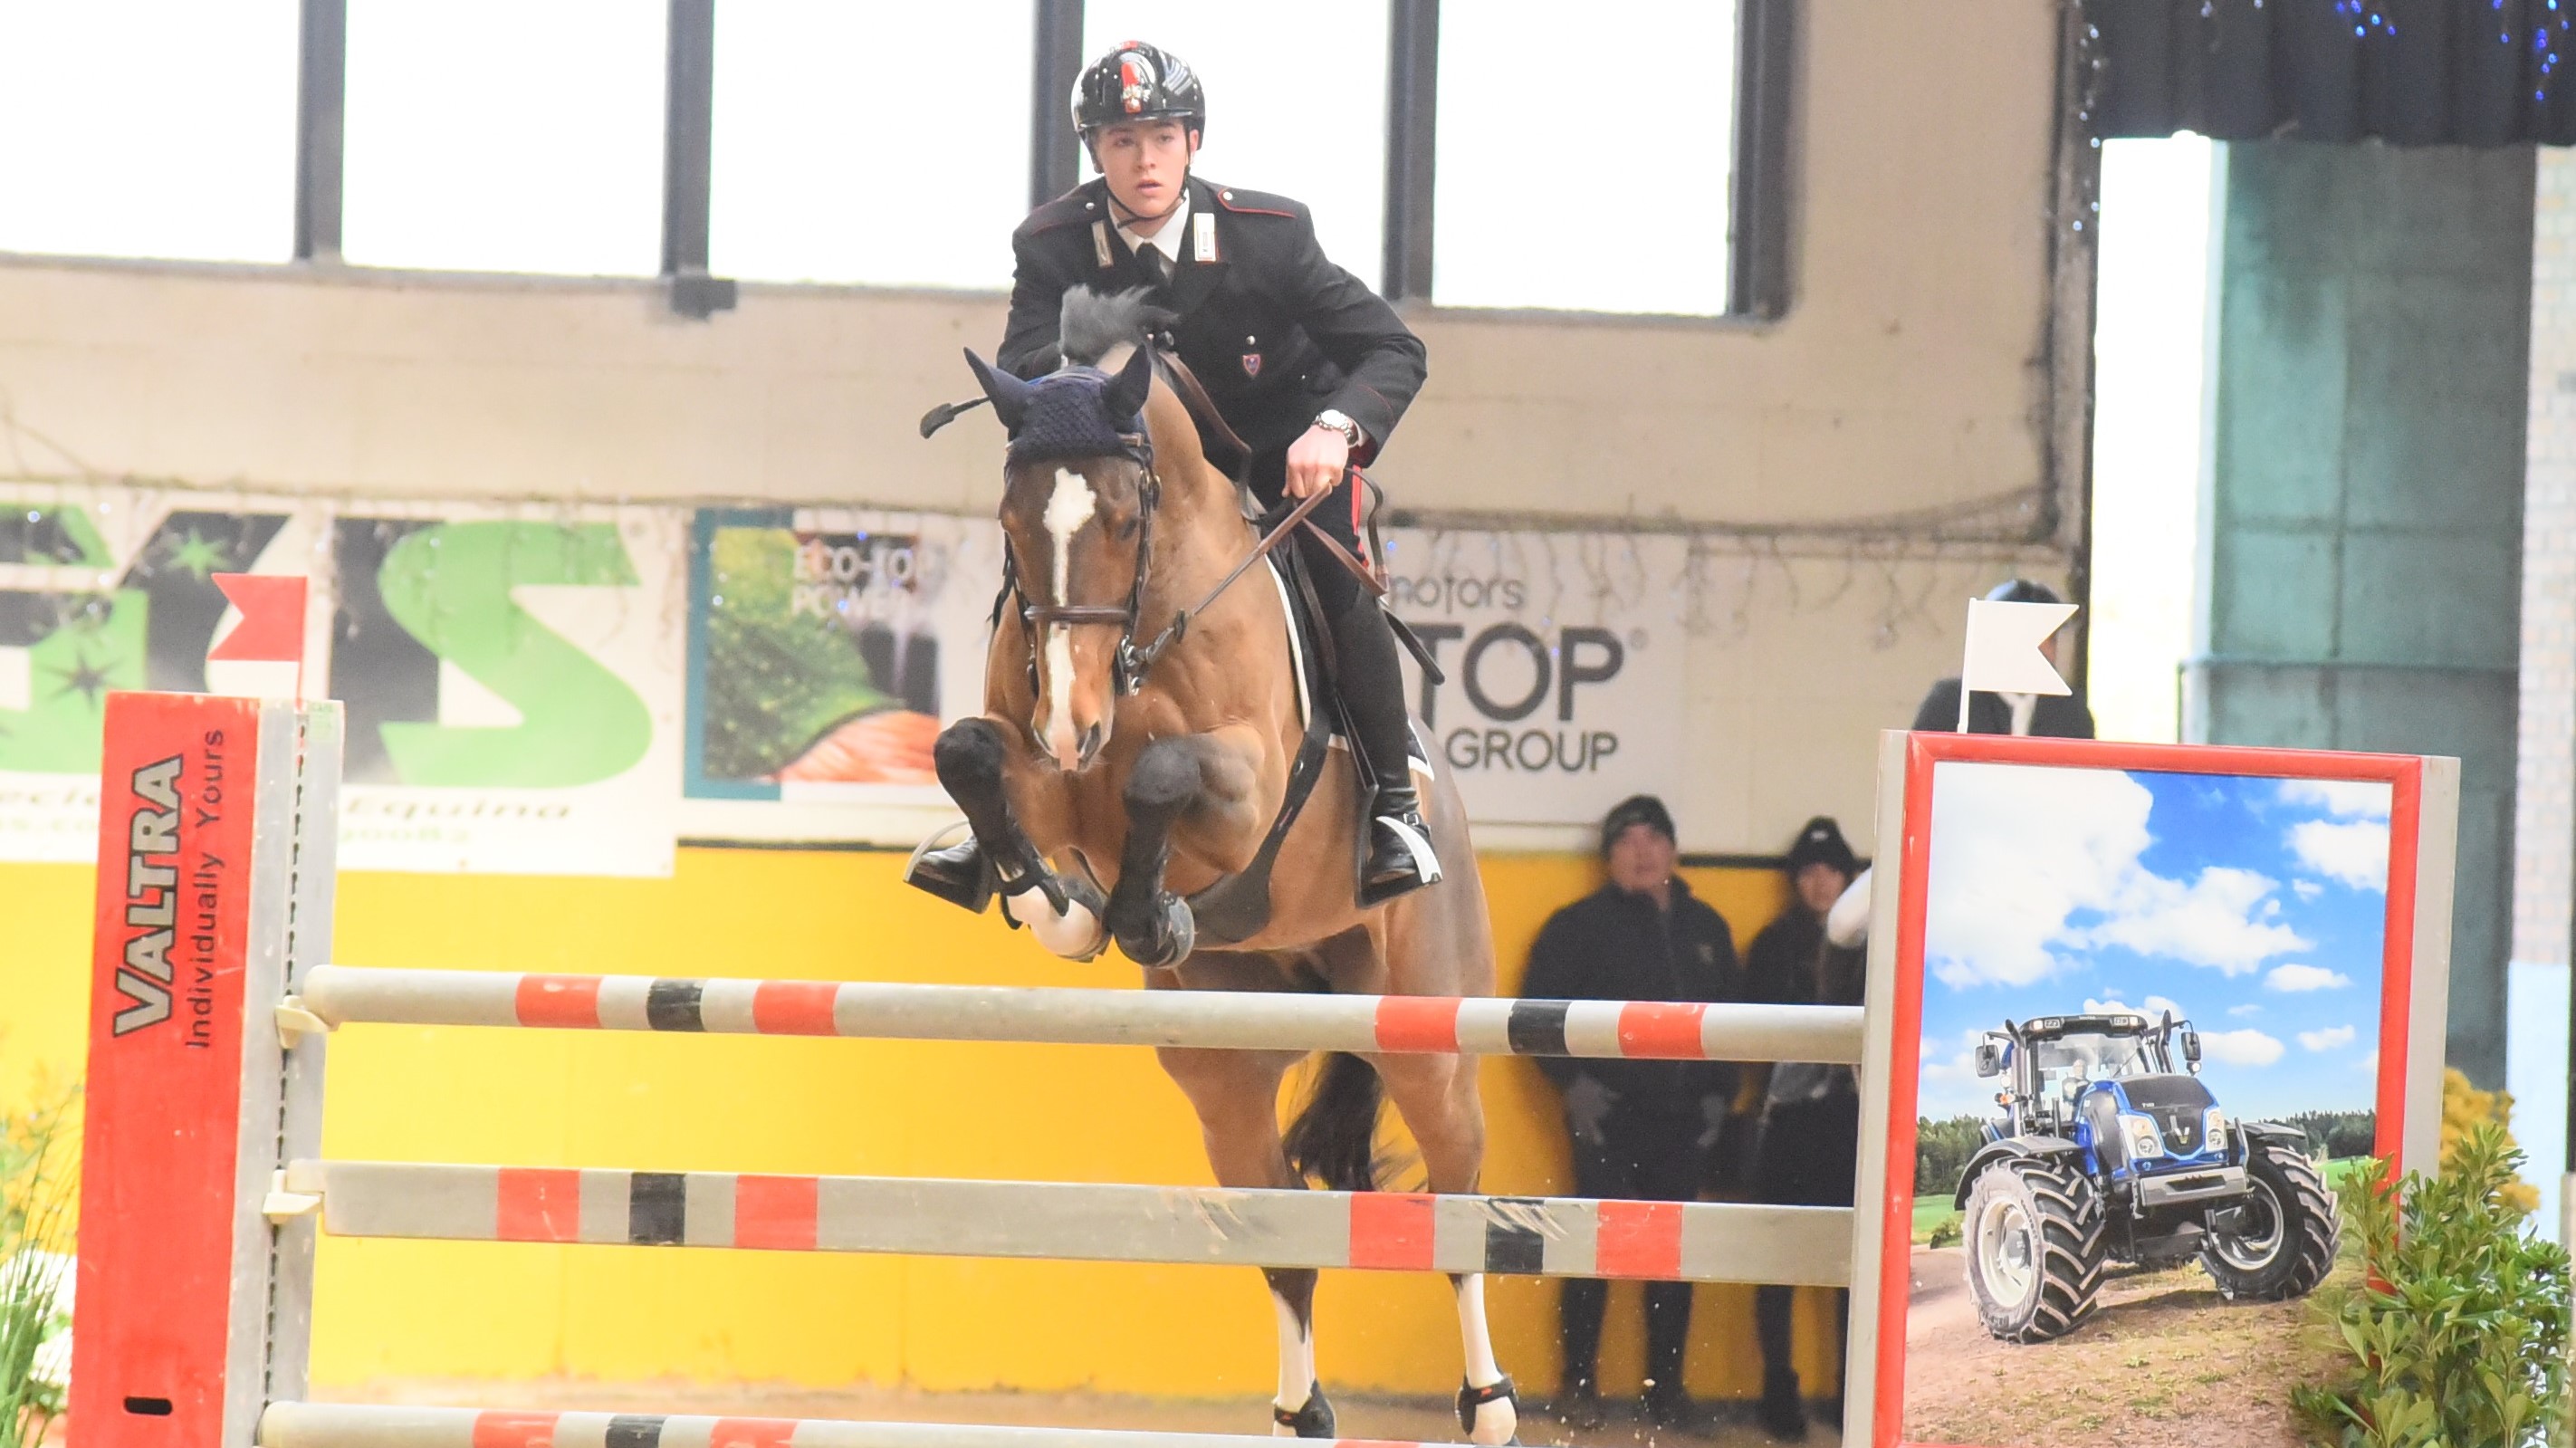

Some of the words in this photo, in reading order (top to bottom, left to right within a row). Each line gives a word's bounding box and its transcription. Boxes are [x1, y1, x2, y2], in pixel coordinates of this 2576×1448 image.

[195, 729, 225, 828] Yours
[1446, 728, 1618, 771] GROUP
[113, 753, 183, 1037] VALTRA
[185, 851, 225, 1048] Individually
